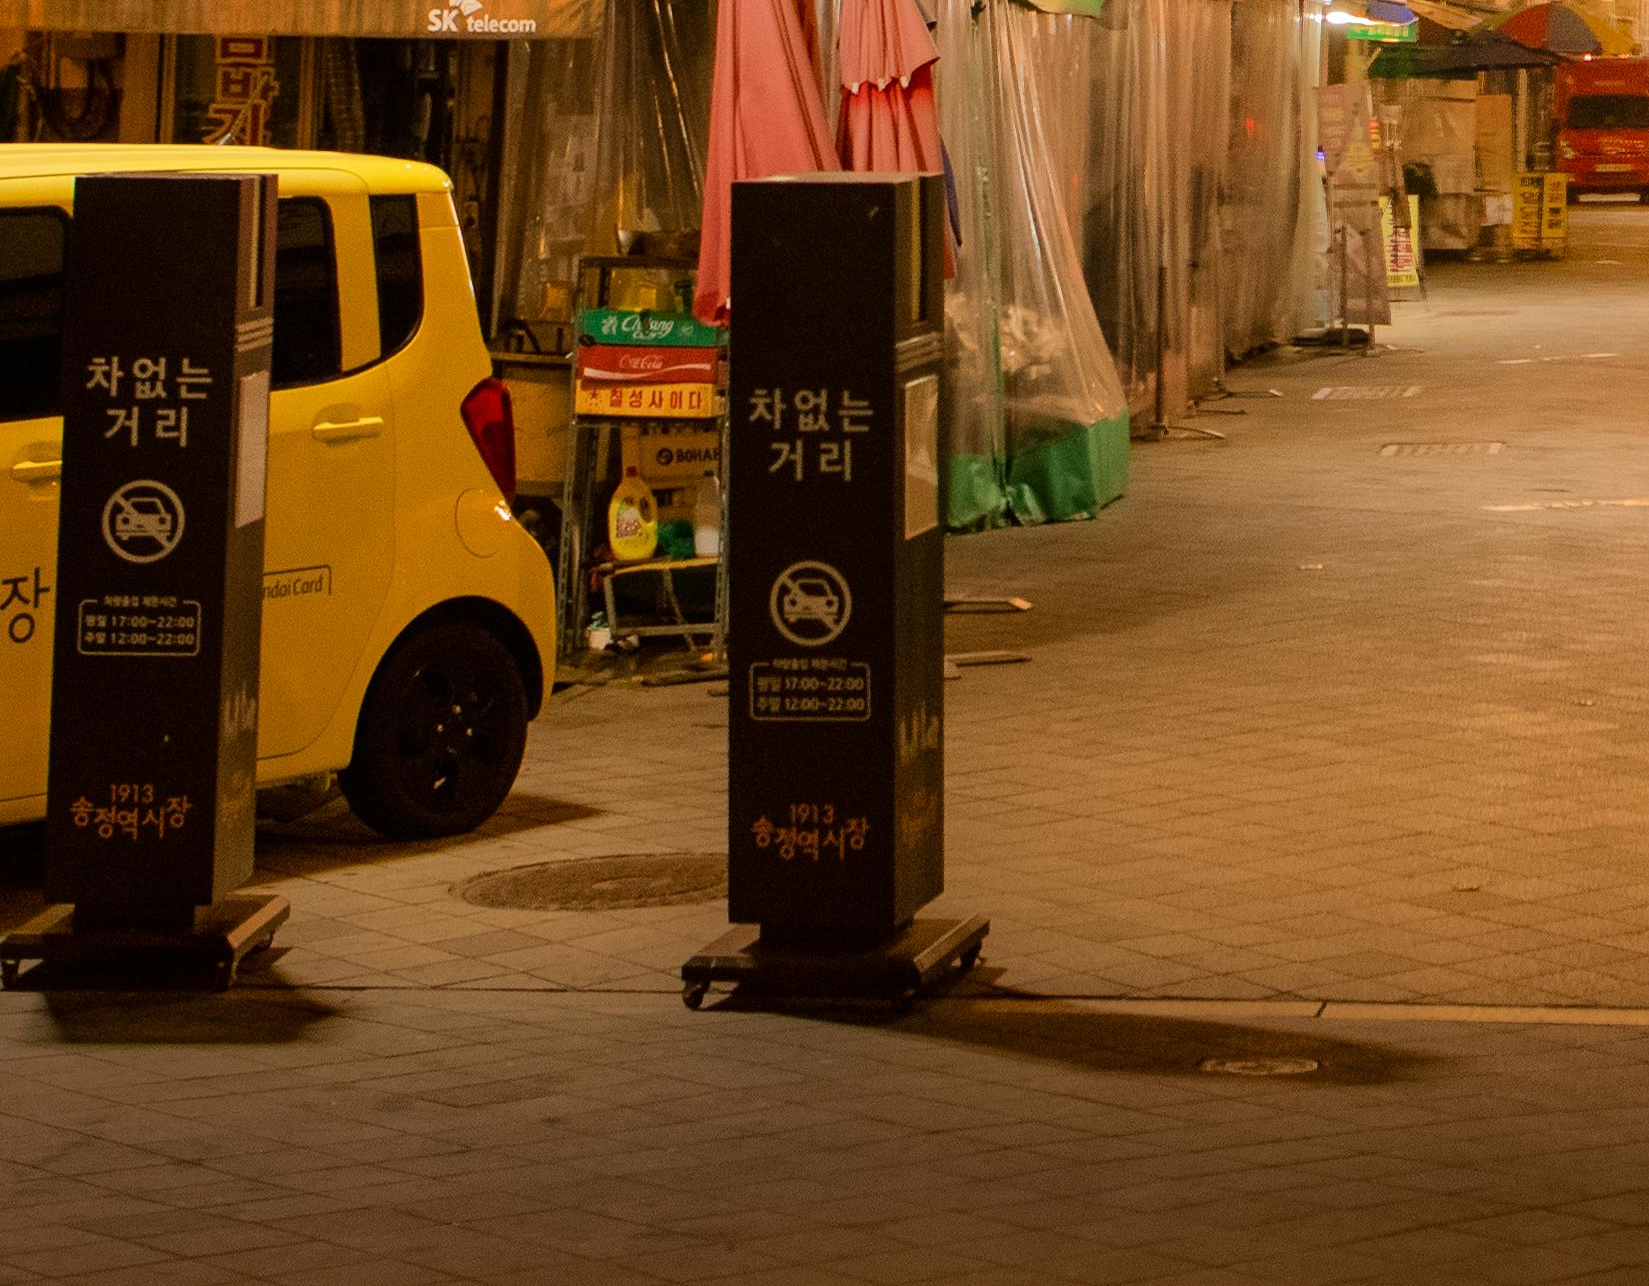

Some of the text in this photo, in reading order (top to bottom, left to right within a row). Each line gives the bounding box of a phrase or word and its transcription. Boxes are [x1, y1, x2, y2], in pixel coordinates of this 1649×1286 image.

[427, 8, 537, 33] SK telecom
[609, 386, 703, 410] 칠성사이다
[103, 405, 189, 448] 거리
[768, 438, 852, 482] 거리
[293, 574, 324, 596] Card
[111, 615, 195, 628] 17:00~22:00
[111, 632, 195, 646] 12:00~22:00
[109, 783, 154, 804] 1913
[69, 795, 193, 841] 송정역시장
[790, 802, 835, 825] 1913
